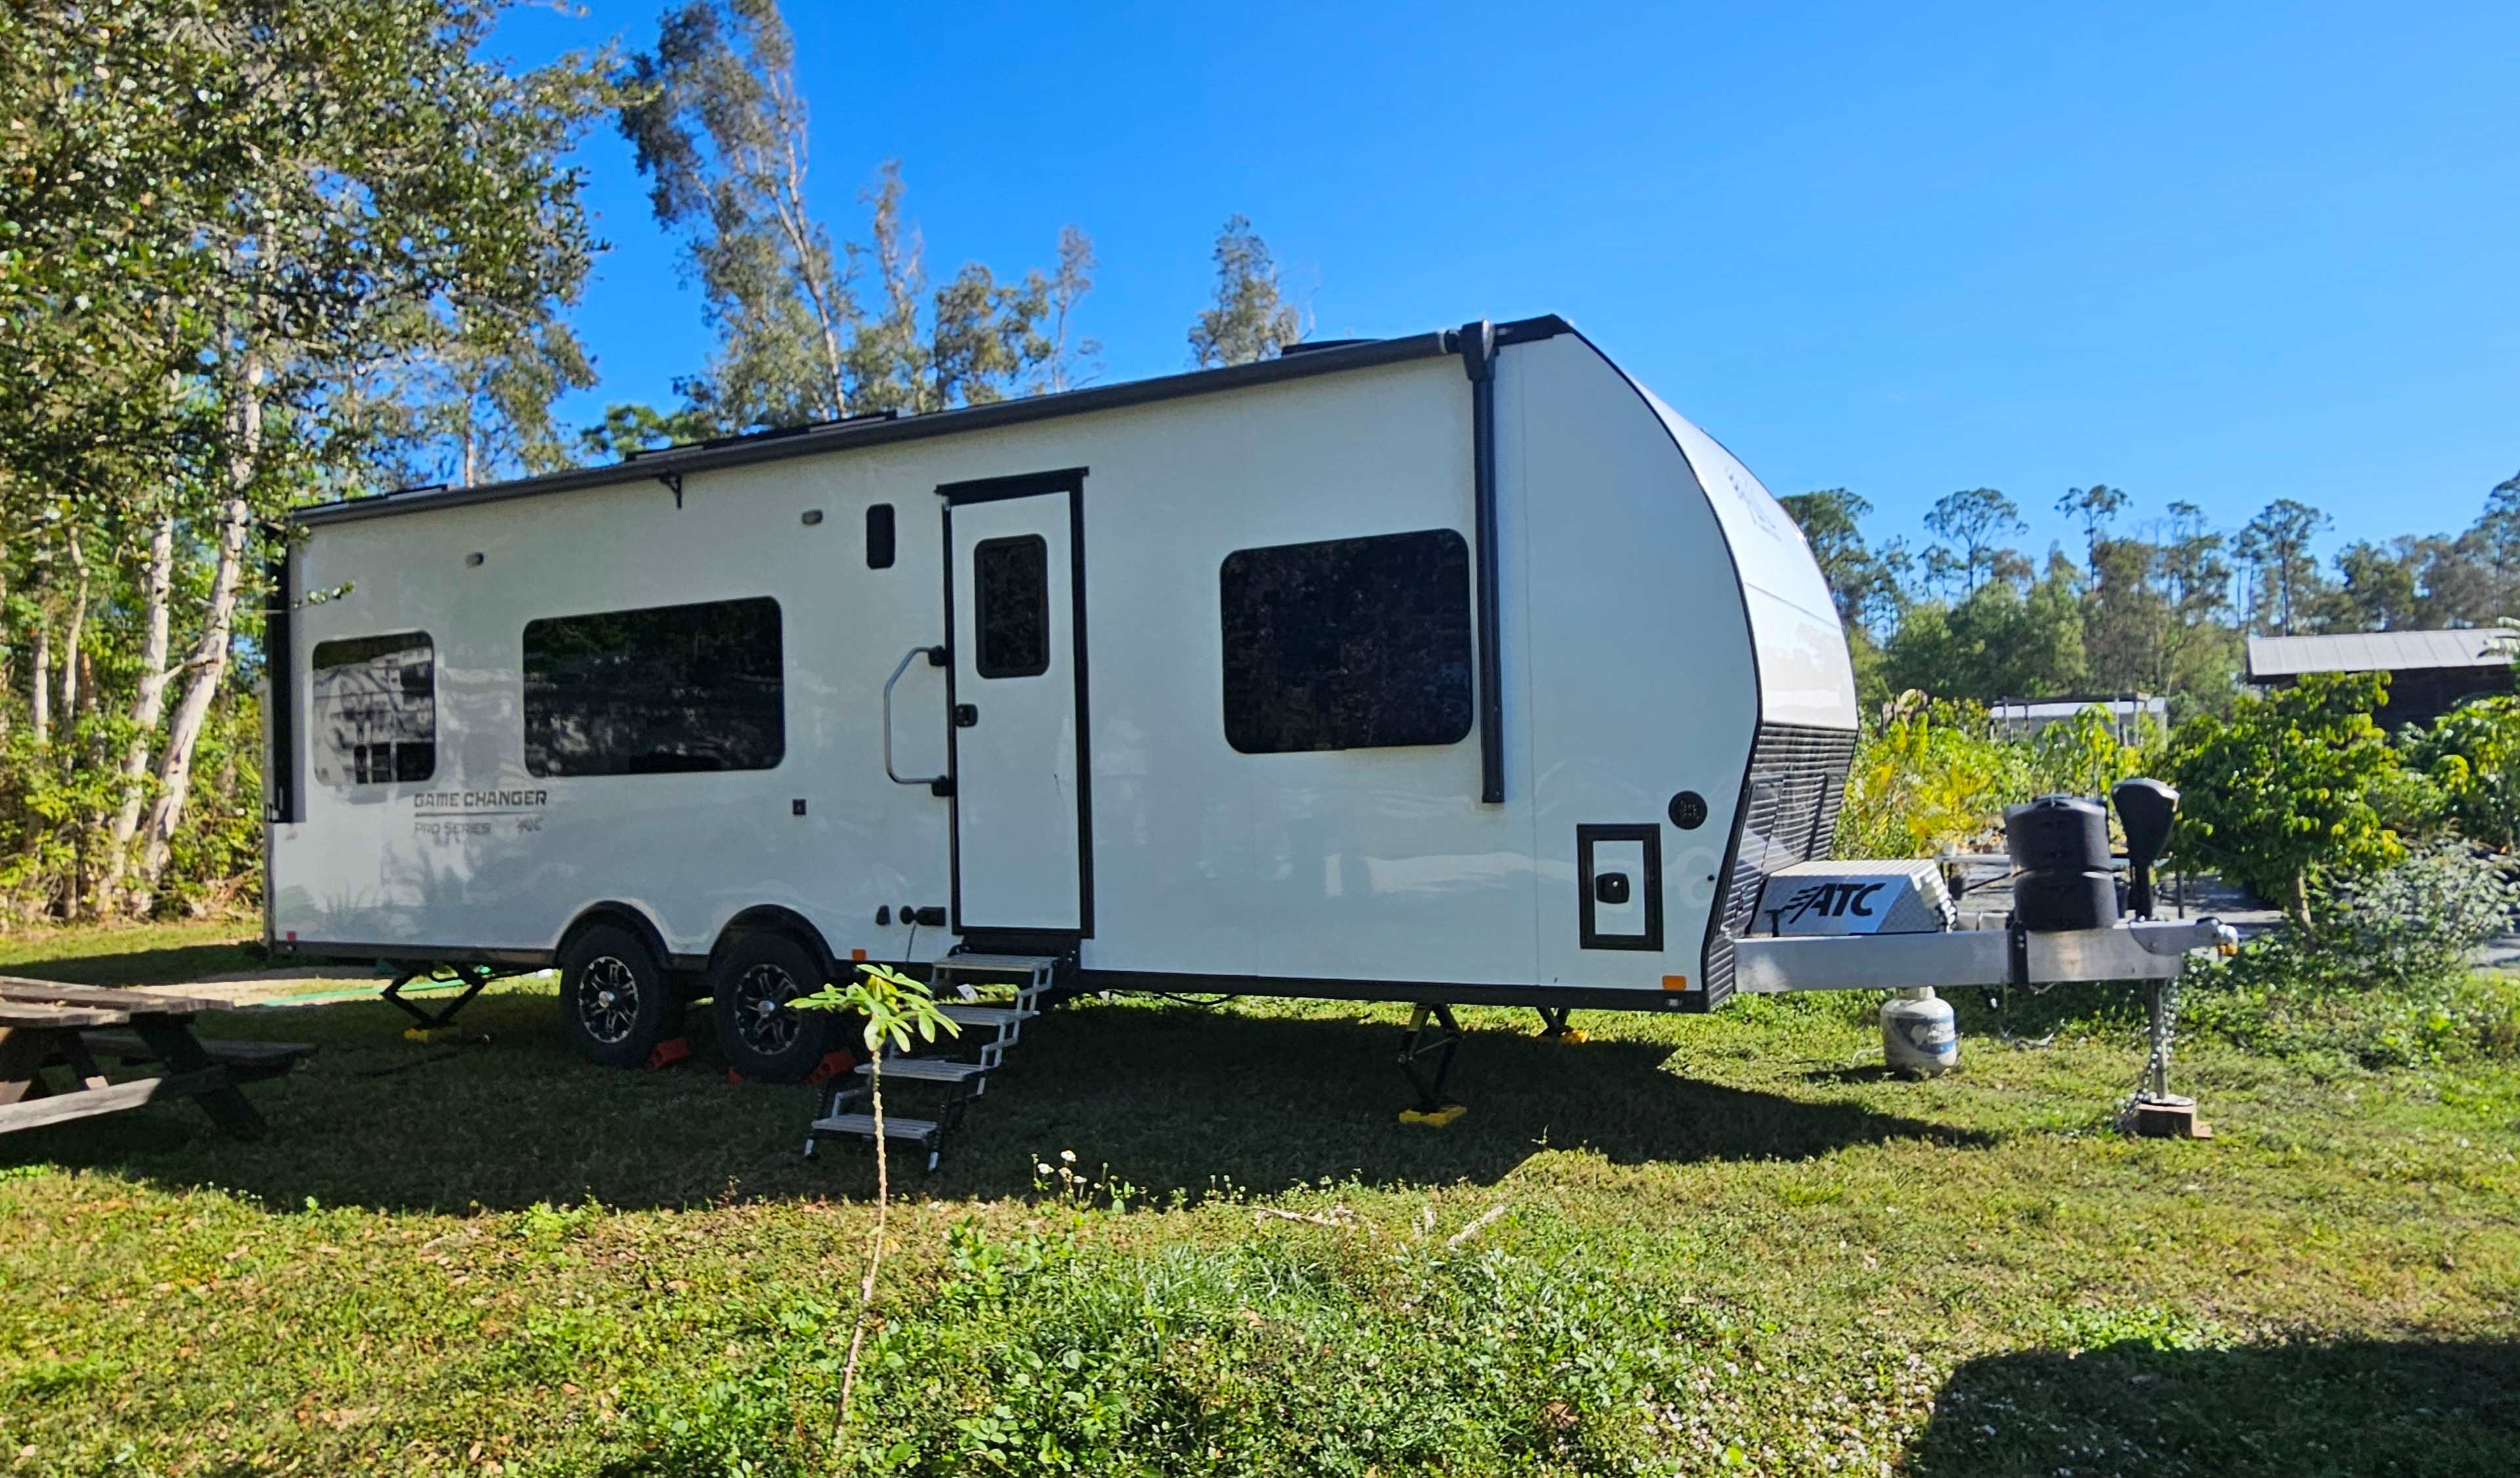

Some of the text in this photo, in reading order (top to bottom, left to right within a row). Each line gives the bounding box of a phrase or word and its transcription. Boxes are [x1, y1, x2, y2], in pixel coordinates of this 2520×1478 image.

[413, 790, 547, 808] GAME CHANGER
[1788, 883, 1886, 924] ATC
